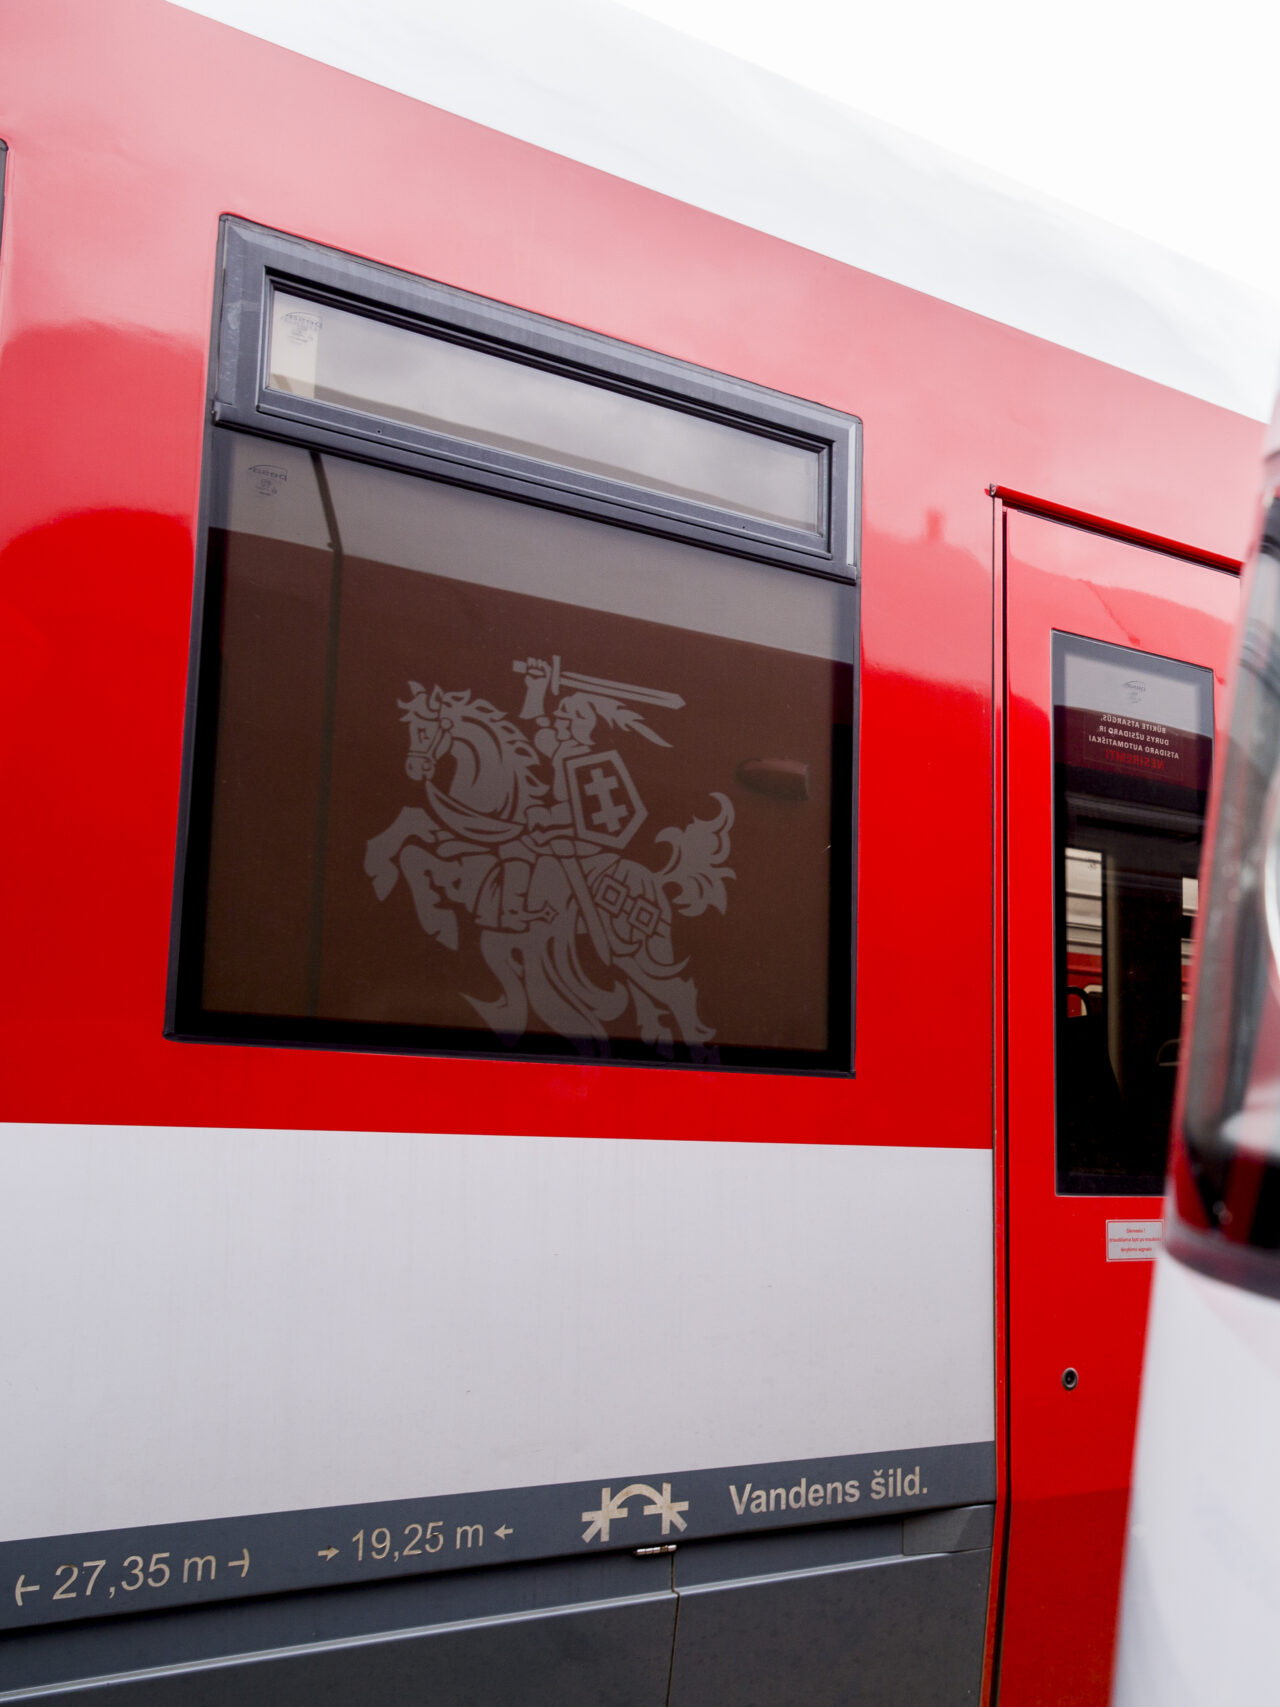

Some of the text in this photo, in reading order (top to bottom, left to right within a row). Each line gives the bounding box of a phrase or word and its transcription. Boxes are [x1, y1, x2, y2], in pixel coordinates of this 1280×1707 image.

[728, 1465, 929, 1516] Vandens šild.
[351, 1521, 485, 1563] 19,25 m
[52, 1552, 217, 1601] 27,35 m
